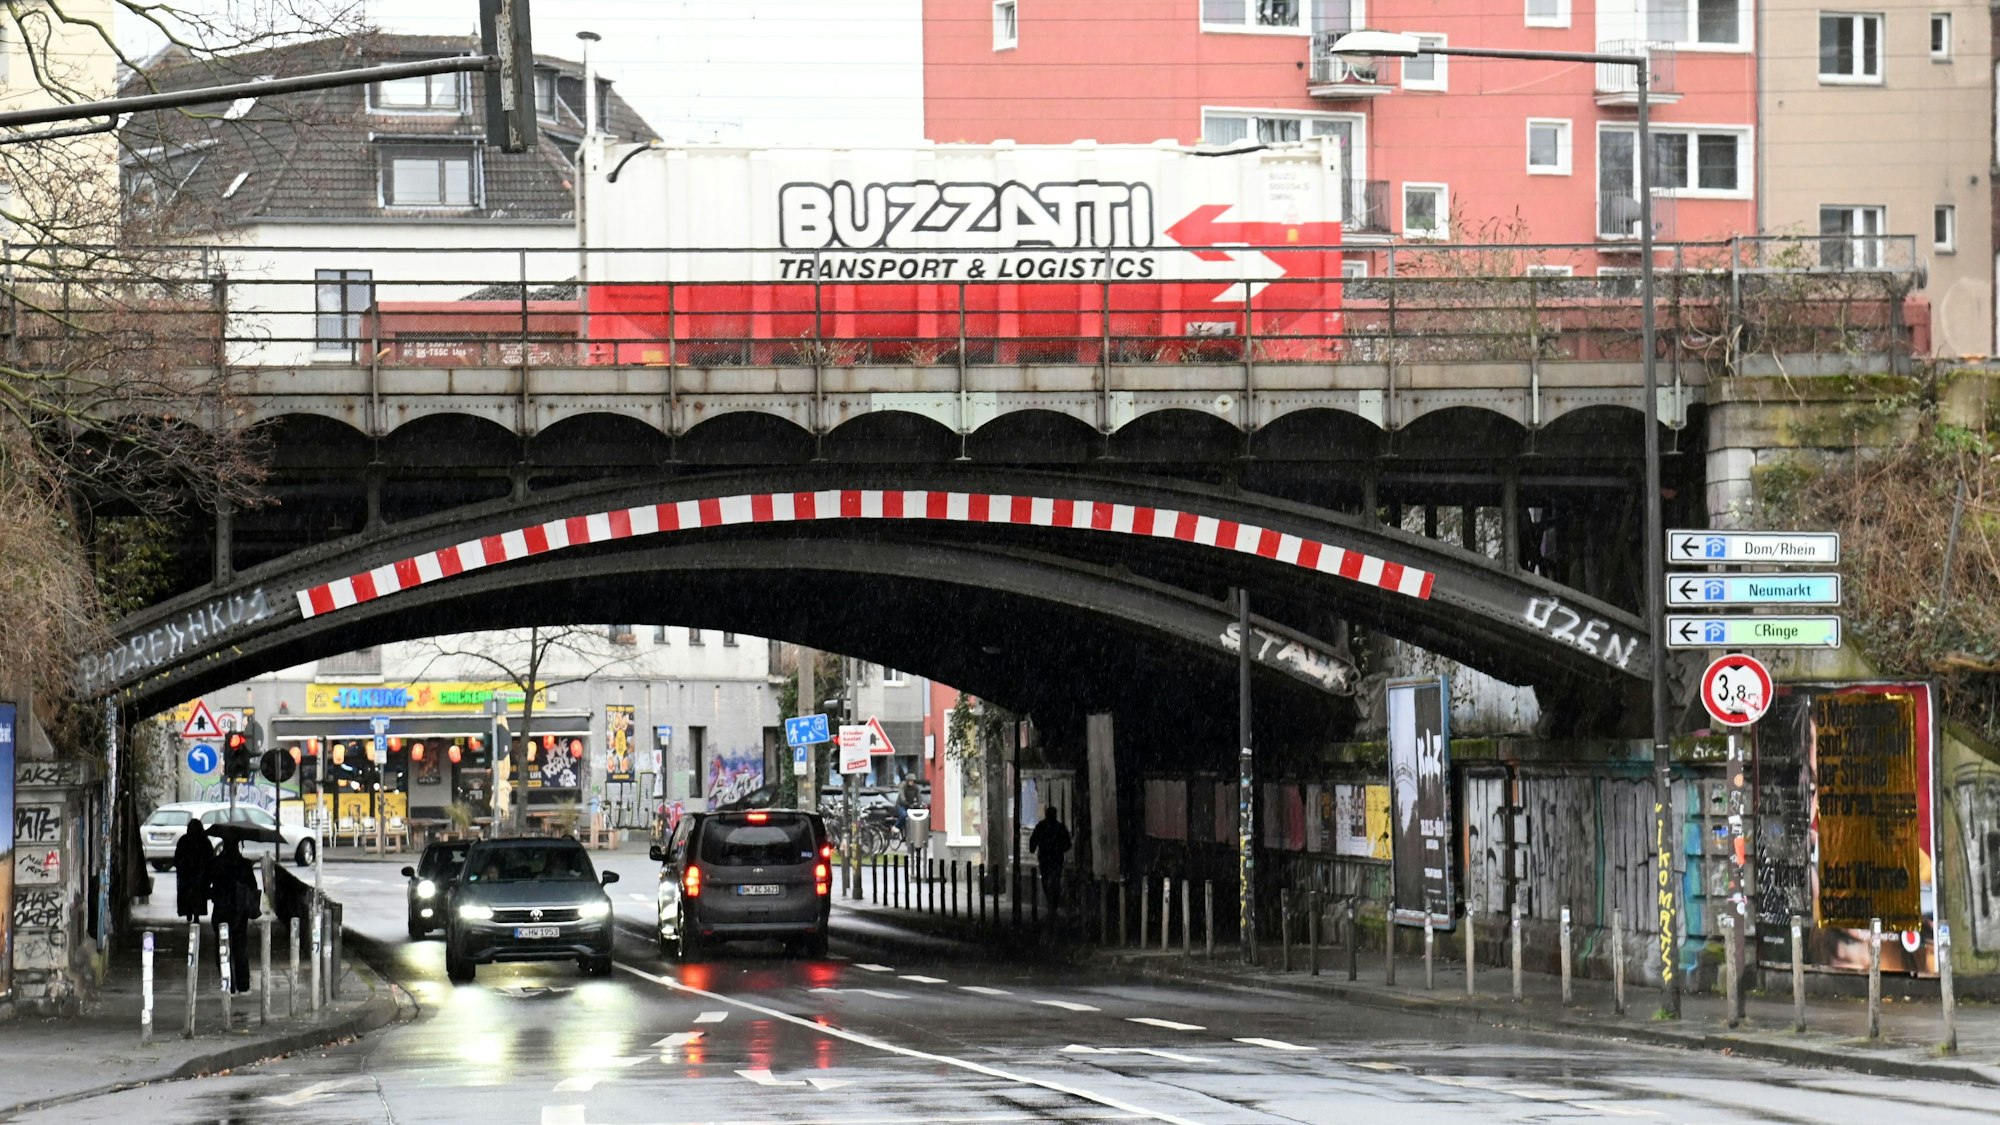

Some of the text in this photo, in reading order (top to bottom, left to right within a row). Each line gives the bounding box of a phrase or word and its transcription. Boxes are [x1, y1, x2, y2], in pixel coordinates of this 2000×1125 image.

[779, 180, 1154, 249] BUZZATTI
[780, 257, 1155, 279] TRANSPORT & LOGISTICS
[1744, 541, 1816, 557] Dom/Rhein
[1749, 583, 1812, 598] Neumarkt
